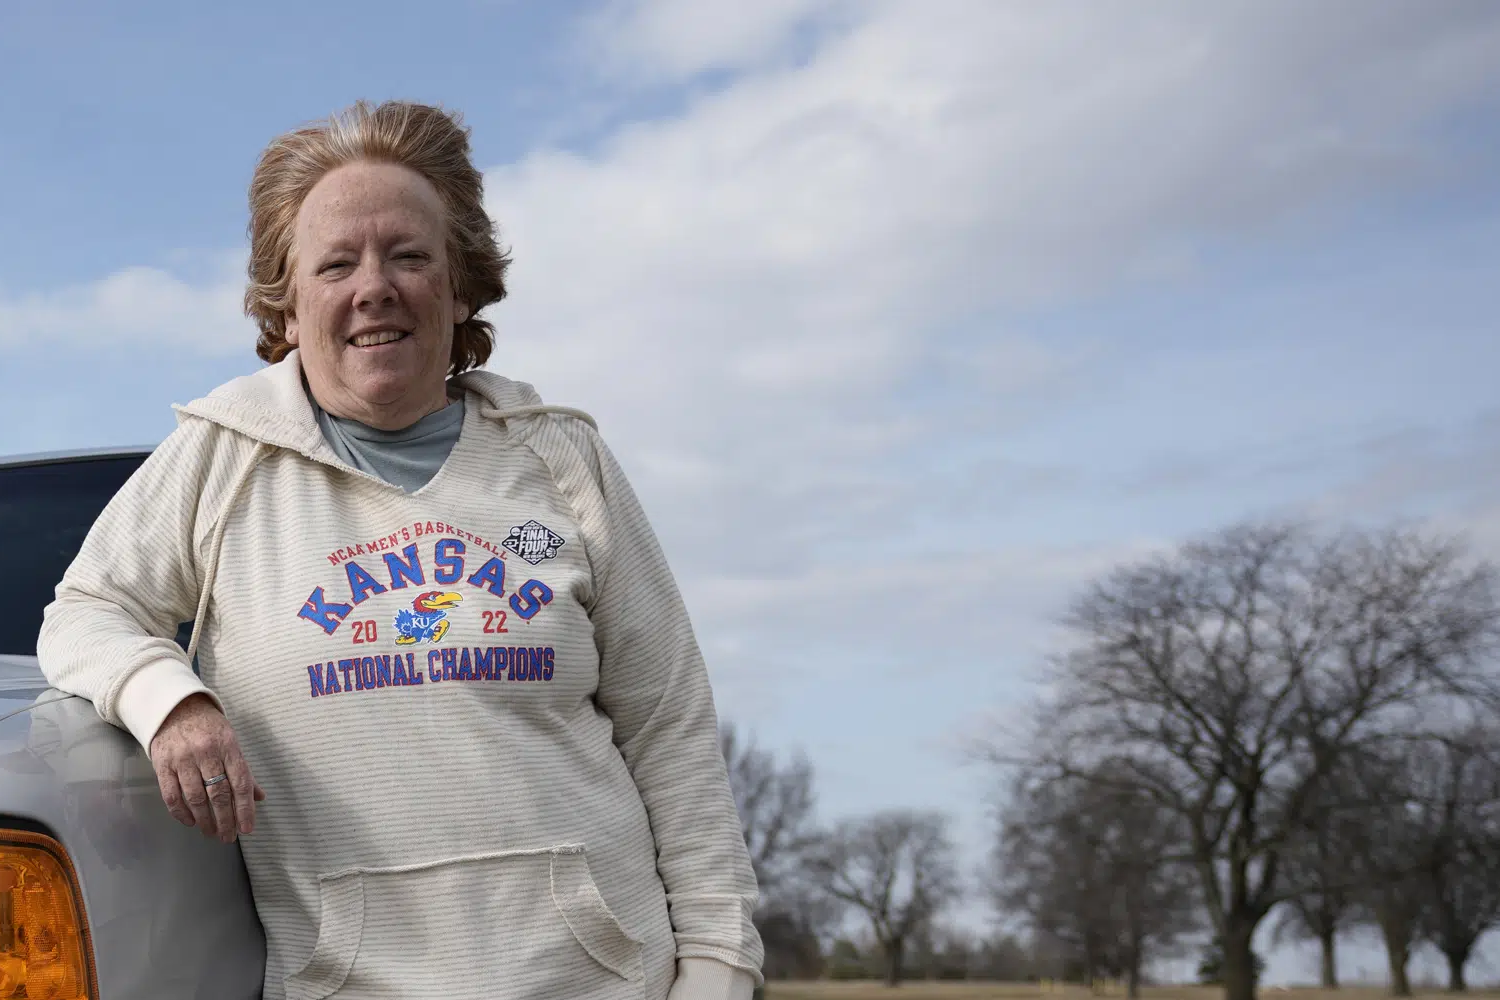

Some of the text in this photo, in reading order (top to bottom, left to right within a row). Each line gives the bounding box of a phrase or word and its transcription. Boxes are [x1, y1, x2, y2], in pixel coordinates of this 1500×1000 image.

[327, 521, 508, 566] NCAA MEN'S BASKETBALL
[520, 529, 549, 541] FINAL
[518, 540, 549, 555] FOUR
[297, 538, 554, 636] KANSAS
[352, 619, 377, 644] 20
[411, 617, 431, 629] KU
[481, 610, 508, 634] 22
[307, 647, 555, 698] NATIONAL CHAMPIONS
